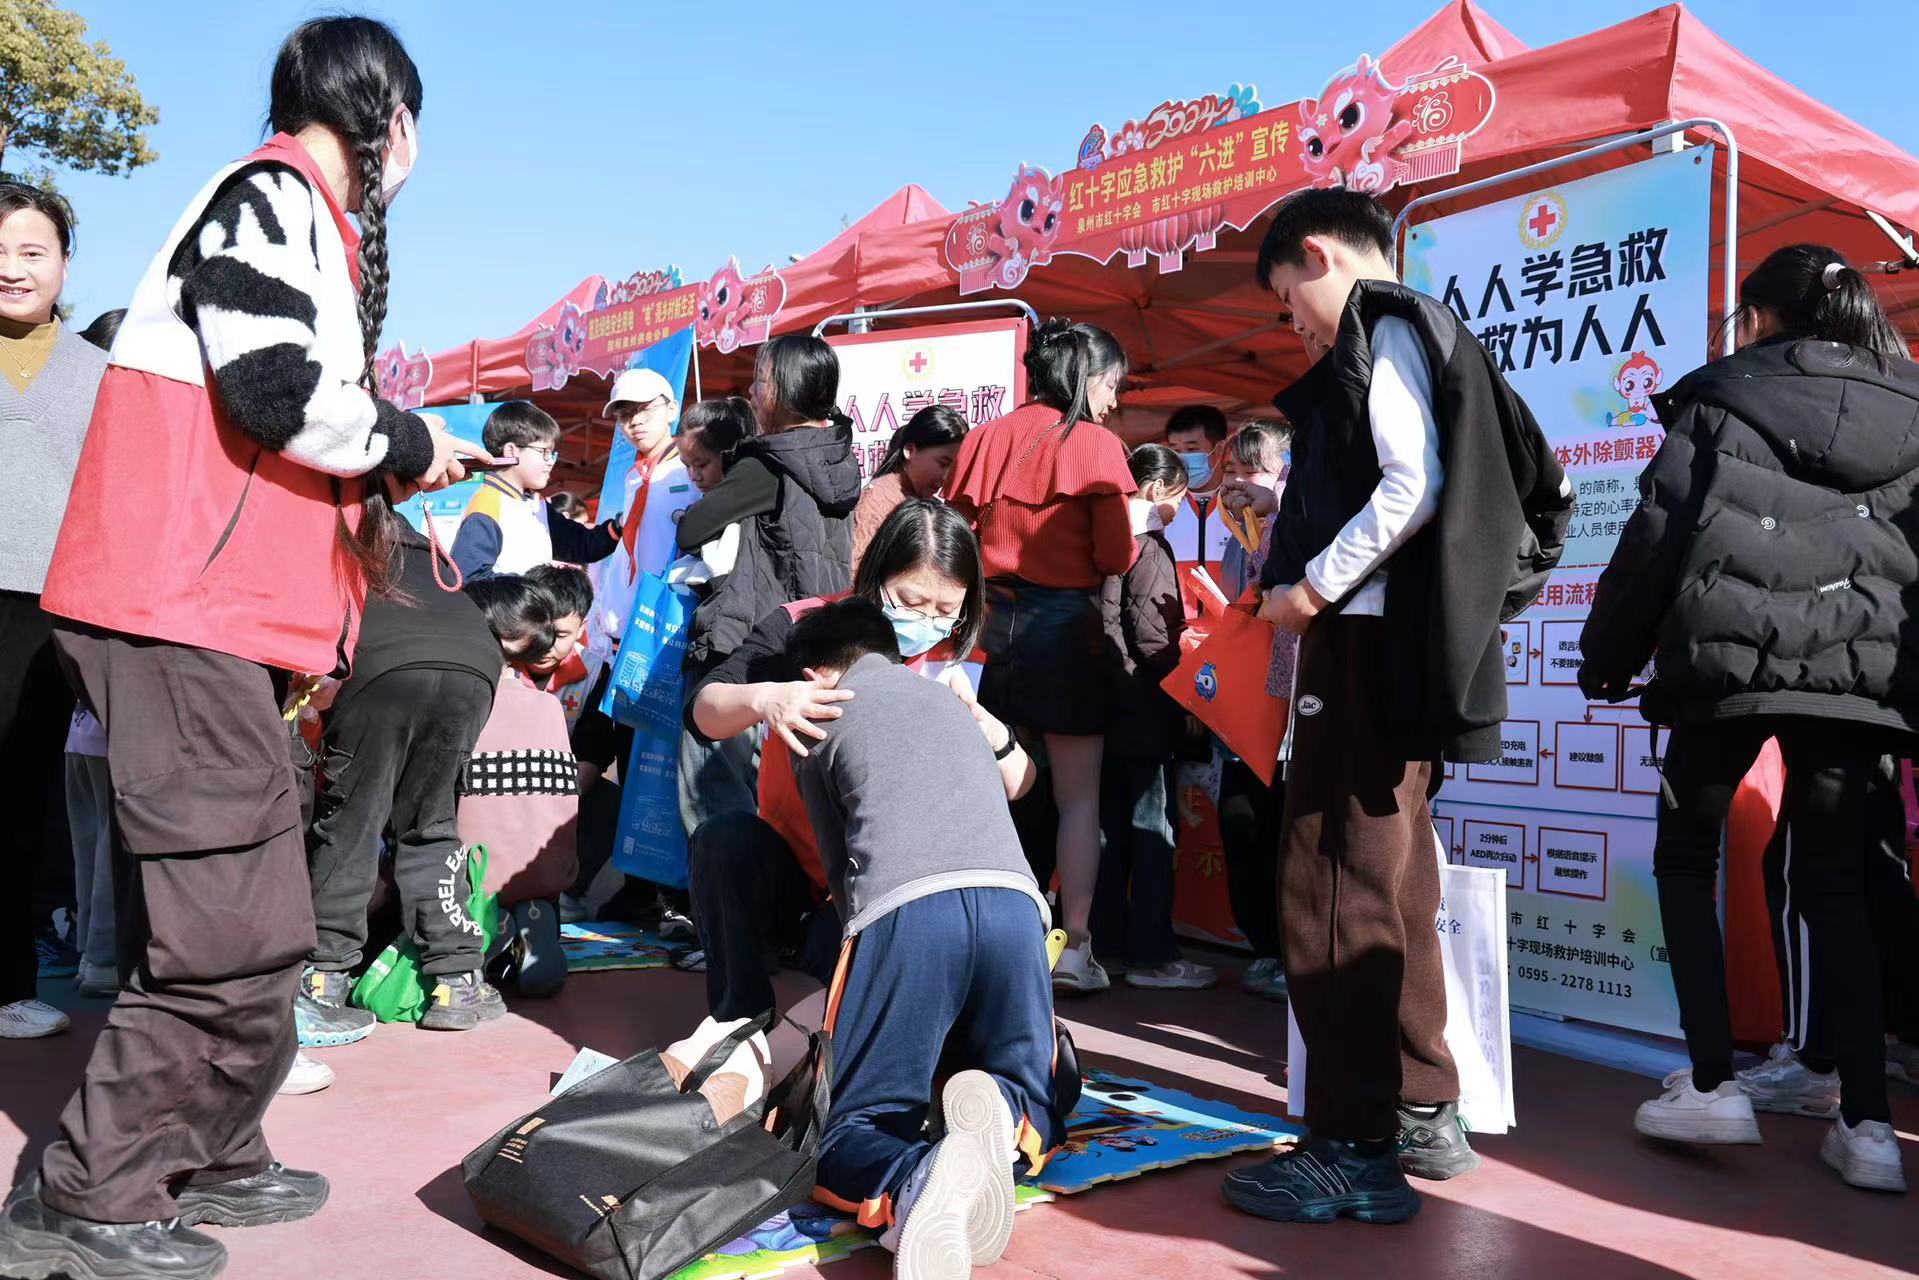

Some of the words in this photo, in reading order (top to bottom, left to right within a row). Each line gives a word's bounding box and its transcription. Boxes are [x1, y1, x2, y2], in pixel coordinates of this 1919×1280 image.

[1146, 98, 1234, 149] 2024
[1077, 203, 1142, 234] 泉州市红十字会
[1152, 165, 1277, 214] 市红十字现场救护培训中心
[1443, 228, 1668, 321] 人人学急救
[843, 385, 1006, 432] 人人学急救
[1518, 965, 1549, 982] 0595
[1560, 973, 1594, 991] 2278
[1598, 980, 1632, 998] 1113
